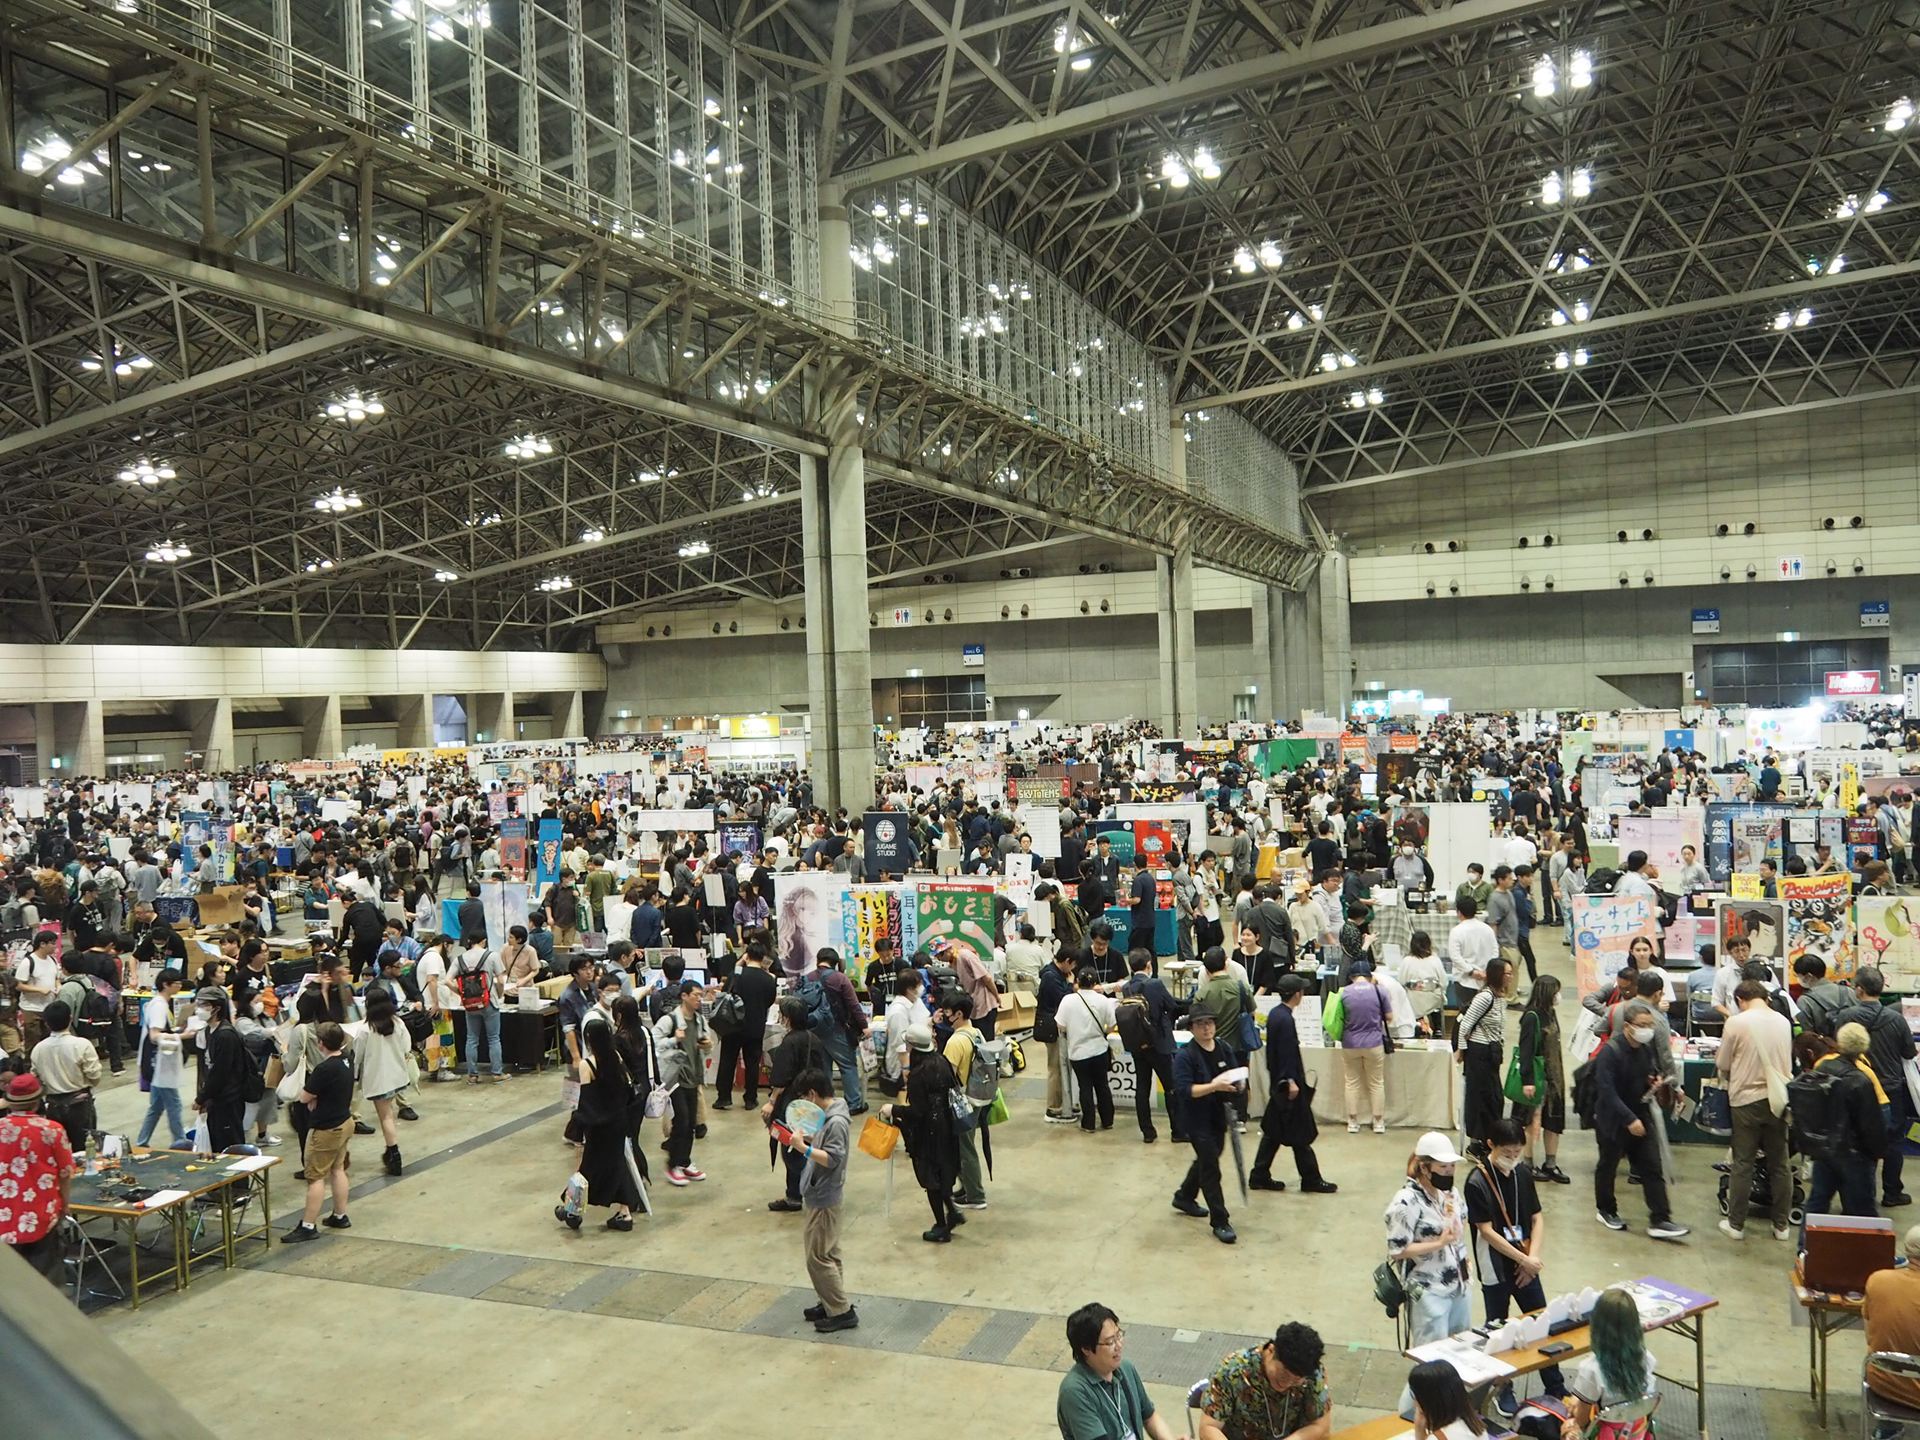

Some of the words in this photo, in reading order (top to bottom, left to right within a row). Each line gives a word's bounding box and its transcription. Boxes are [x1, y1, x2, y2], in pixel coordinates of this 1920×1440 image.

[1878, 604, 1885, 612] 5
[1709, 611, 1715, 619] 5
[975, 646, 981, 654] 6
[920, 894, 976, 916] おもさ
[1580, 901, 1644, 928] インサイト
[1590, 921, 1643, 935] アウト
